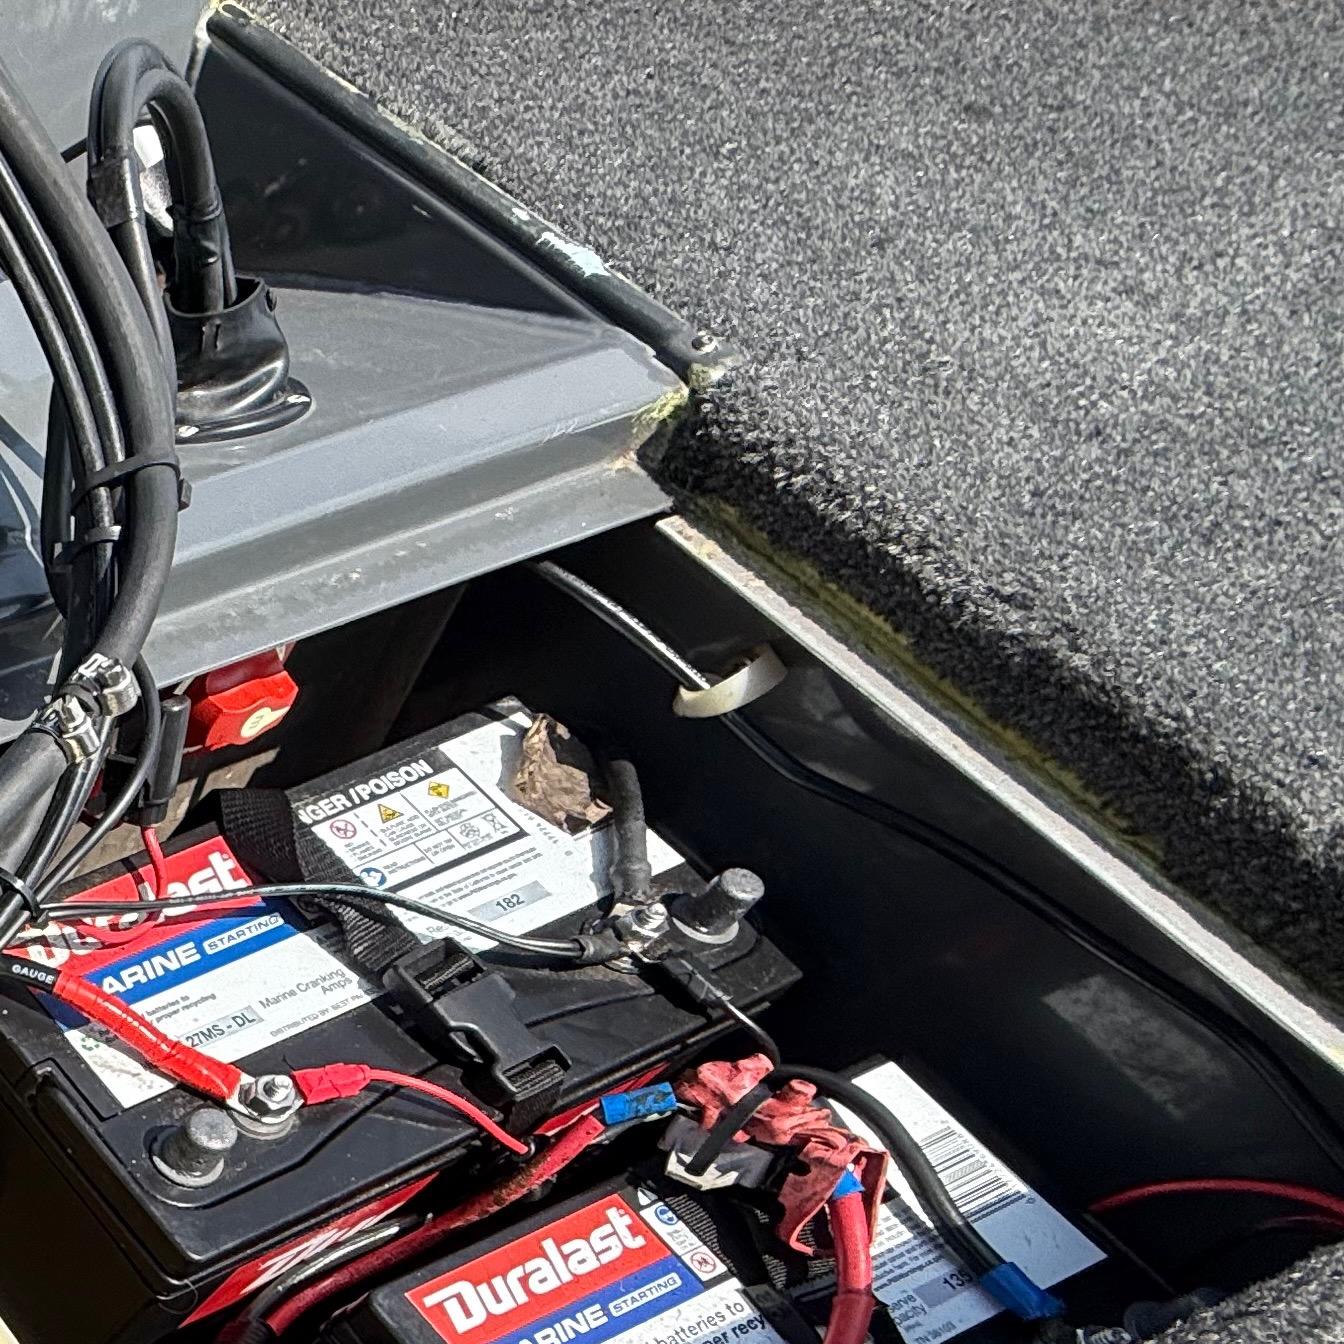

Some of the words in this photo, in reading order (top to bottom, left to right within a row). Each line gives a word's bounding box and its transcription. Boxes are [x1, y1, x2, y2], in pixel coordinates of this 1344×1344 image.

[494, 890, 525, 913] 182
[100, 941, 201, 996] ARINE
[207, 914, 281, 952] STARTING
[12, 964, 55, 984] GAUGE
[185, 1023, 221, 1048] 27MS
[232, 1009, 256, 1028] DL
[423, 1207, 647, 1334] Duralast
[611, 1276, 678, 1315] STARTING
[725, 1300, 745, 1317] to
[888, 1293, 916, 1313] serve
[732, 1313, 767, 1339] recy
